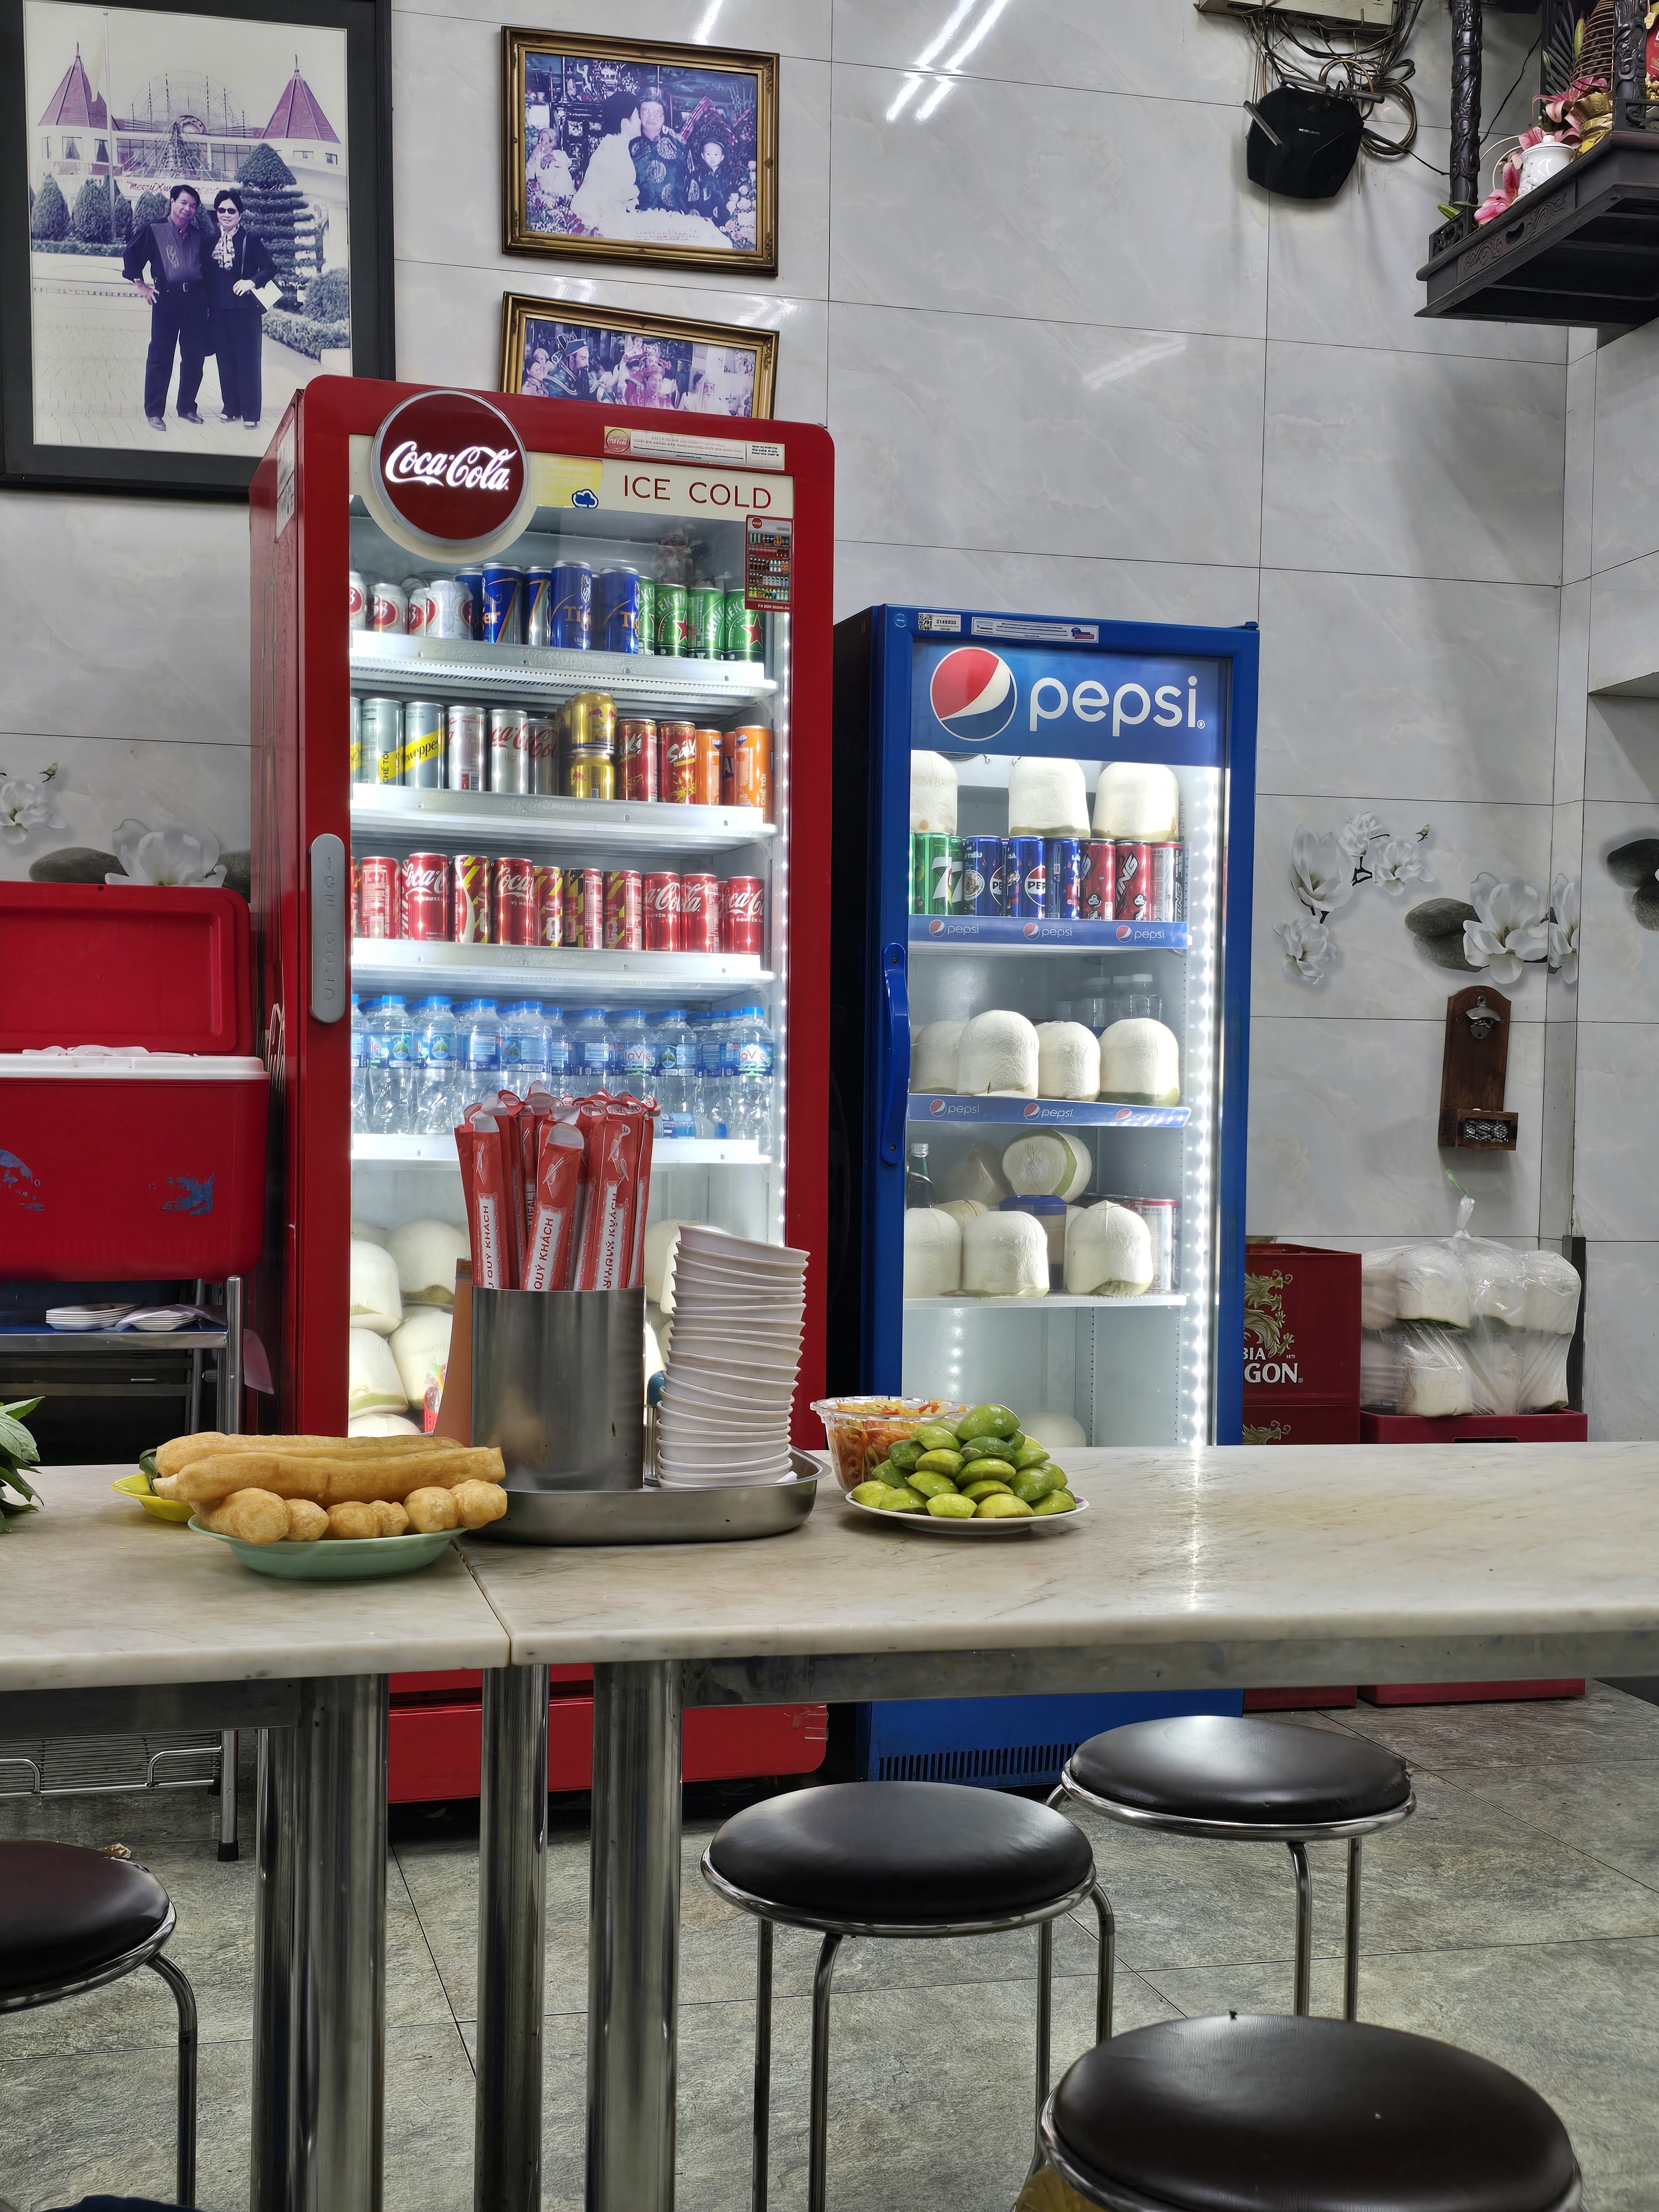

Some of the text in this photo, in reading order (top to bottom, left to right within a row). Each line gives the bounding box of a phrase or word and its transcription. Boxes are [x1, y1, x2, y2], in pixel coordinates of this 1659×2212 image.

[385, 441, 518, 490] Coca-Cola
[624, 474, 772, 509] ICE COLD
[563, 605, 591, 632] Tig
[1029, 675, 1197, 737] pepsi
[947, 924, 979, 935] pepsi
[1041, 927, 1072, 938] pepsi
[1134, 930, 1165, 940] pepsi
[947, 1104, 980, 1115] pepsi
[1041, 1108, 1073, 1119] pepsi
[534, 1218, 554, 1290] QUÝ KHÁCH
[1243, 1347, 1266, 1360] BIA
[1244, 1363, 1298, 1384] GON
